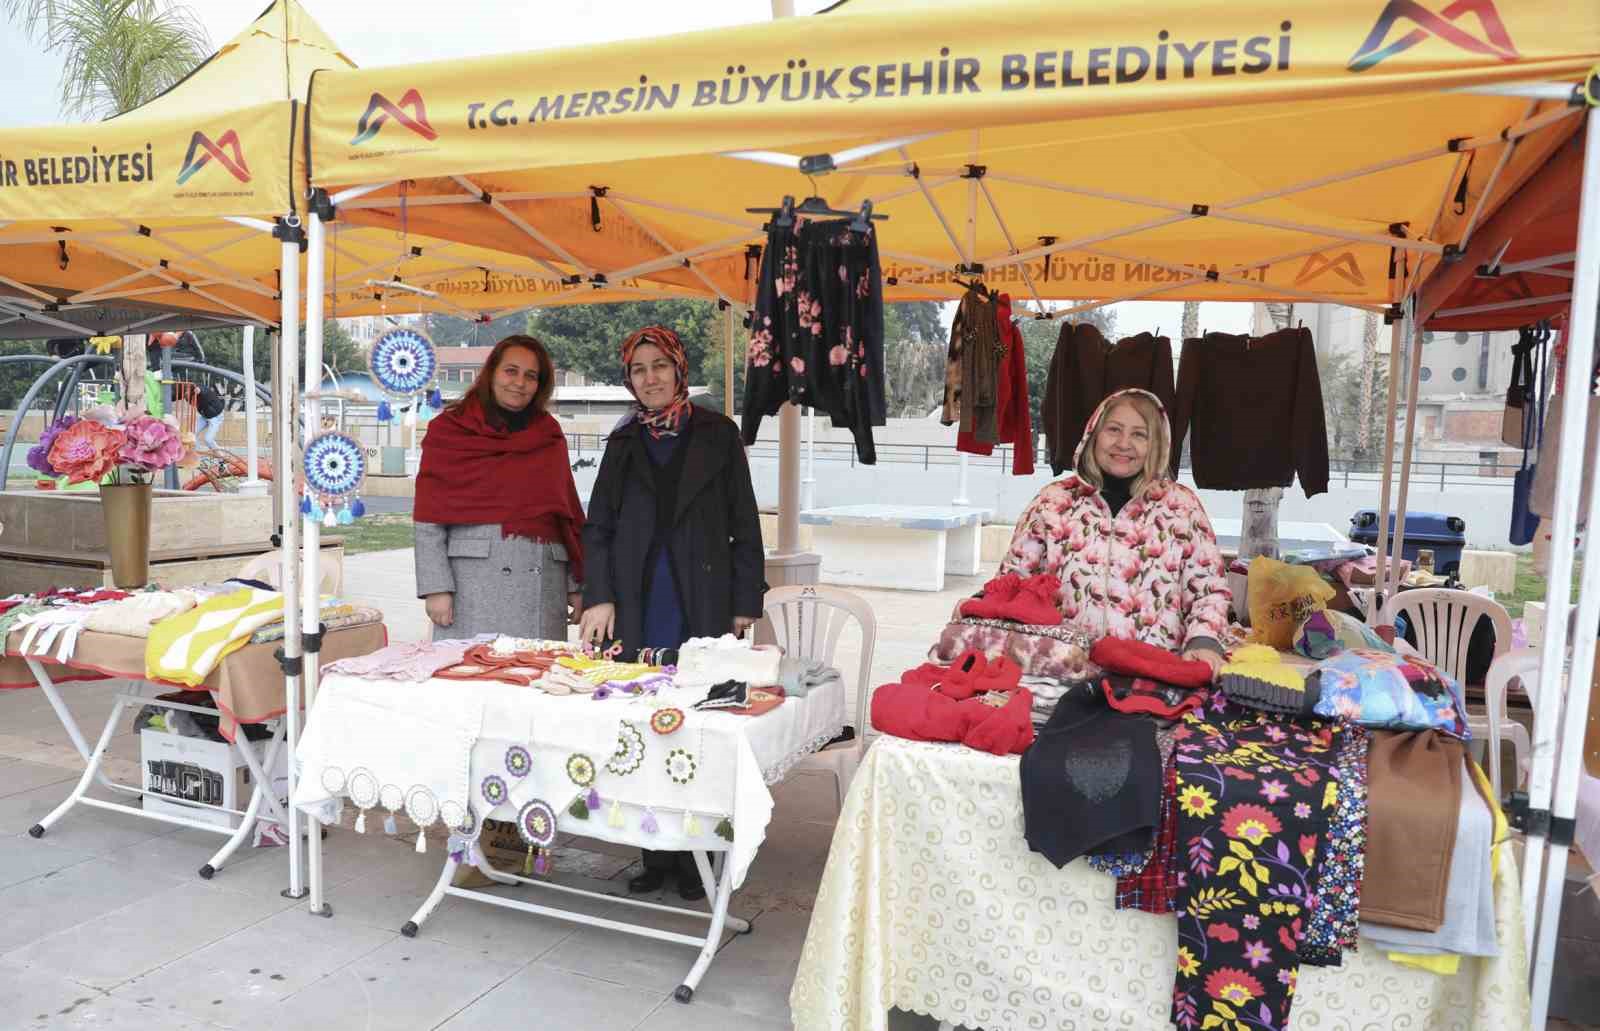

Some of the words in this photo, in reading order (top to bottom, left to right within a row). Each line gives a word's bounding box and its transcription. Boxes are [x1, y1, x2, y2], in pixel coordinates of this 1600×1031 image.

[467, 101, 519, 130] T.C.
[528, 74, 681, 124] MERSİN
[691, 46, 981, 108] BÜYÜKŞEHİR
[1001, 20, 1293, 92] BELEDİYESİ
[24, 142, 153, 186] BELEDİYESİ
